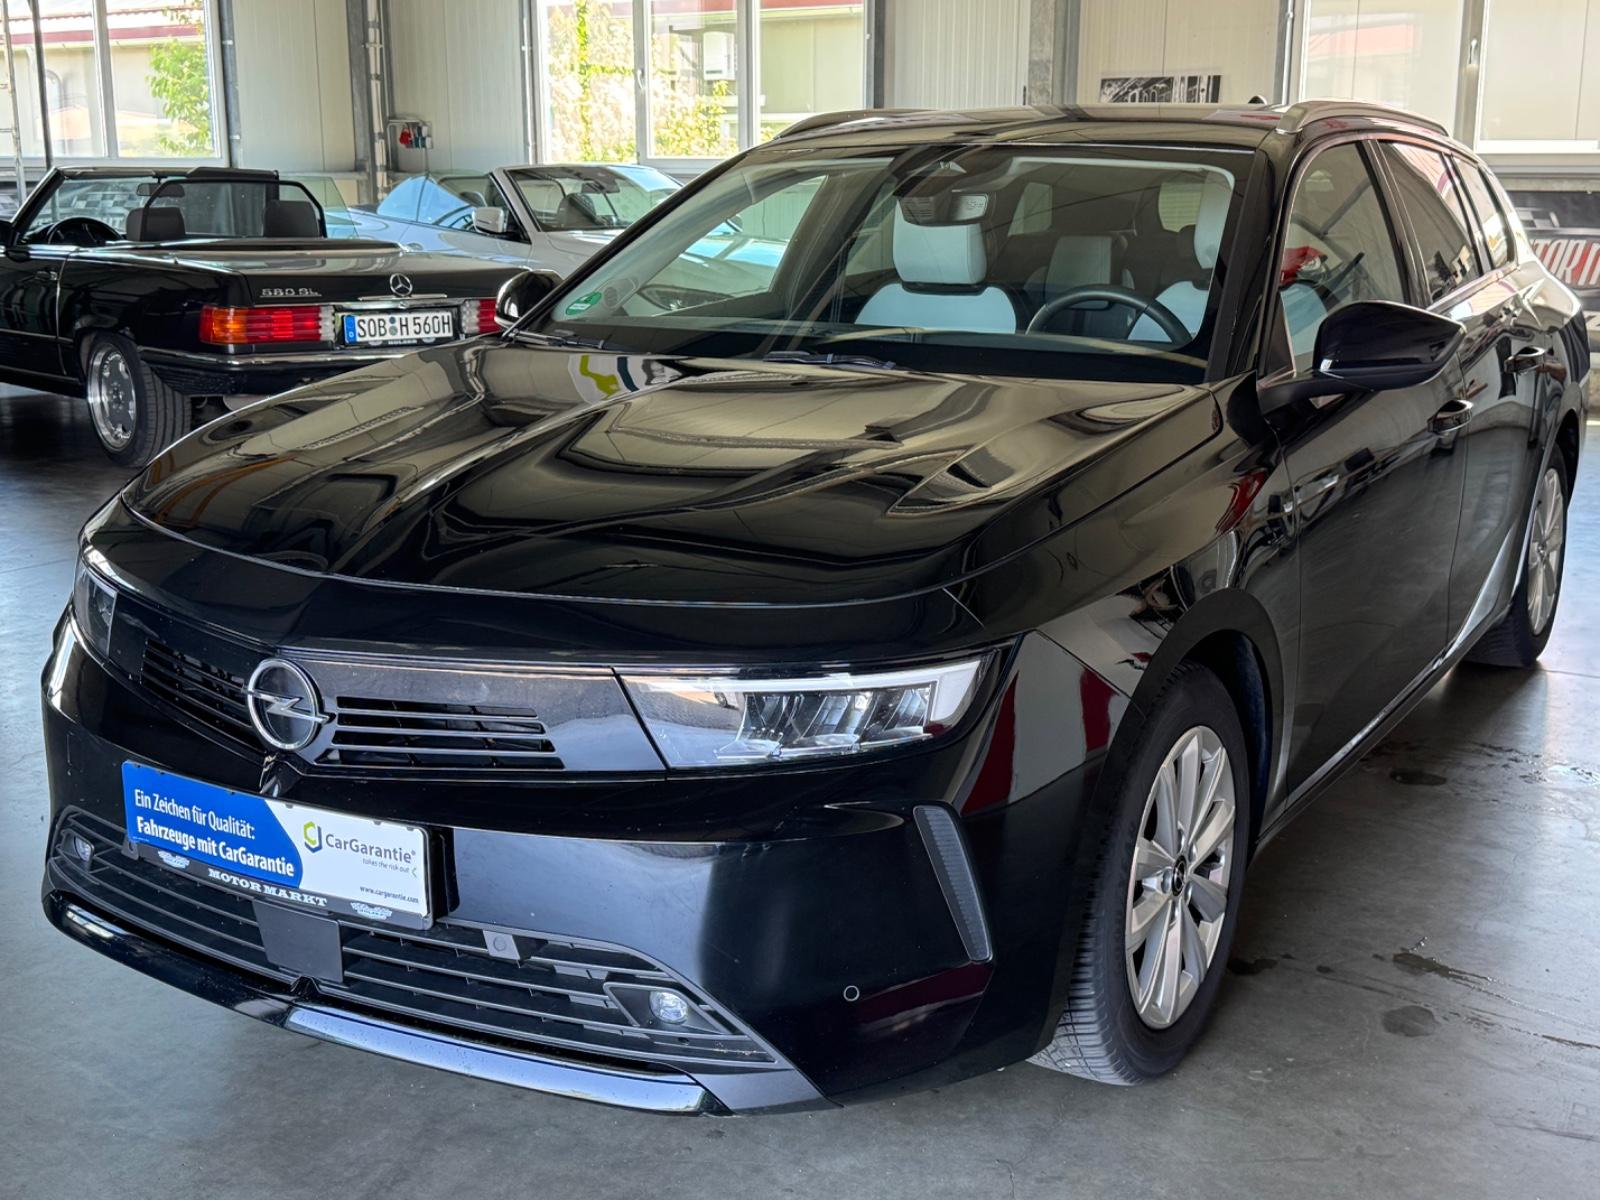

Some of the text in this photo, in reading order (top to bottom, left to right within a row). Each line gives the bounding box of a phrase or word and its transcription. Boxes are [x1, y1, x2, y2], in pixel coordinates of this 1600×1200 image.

[357, 318, 388, 338] SOB
[399, 317, 409, 336] H
[413, 314, 451, 335] 560H
[134, 788, 256, 840] Ein Zeichen für Qualität:
[136, 815, 196, 851] Fahrzeuge
[197, 837, 217, 856] mit
[218, 842, 295, 877] CarGarantie
[208, 868, 328, 907] MOTOR MARKT
